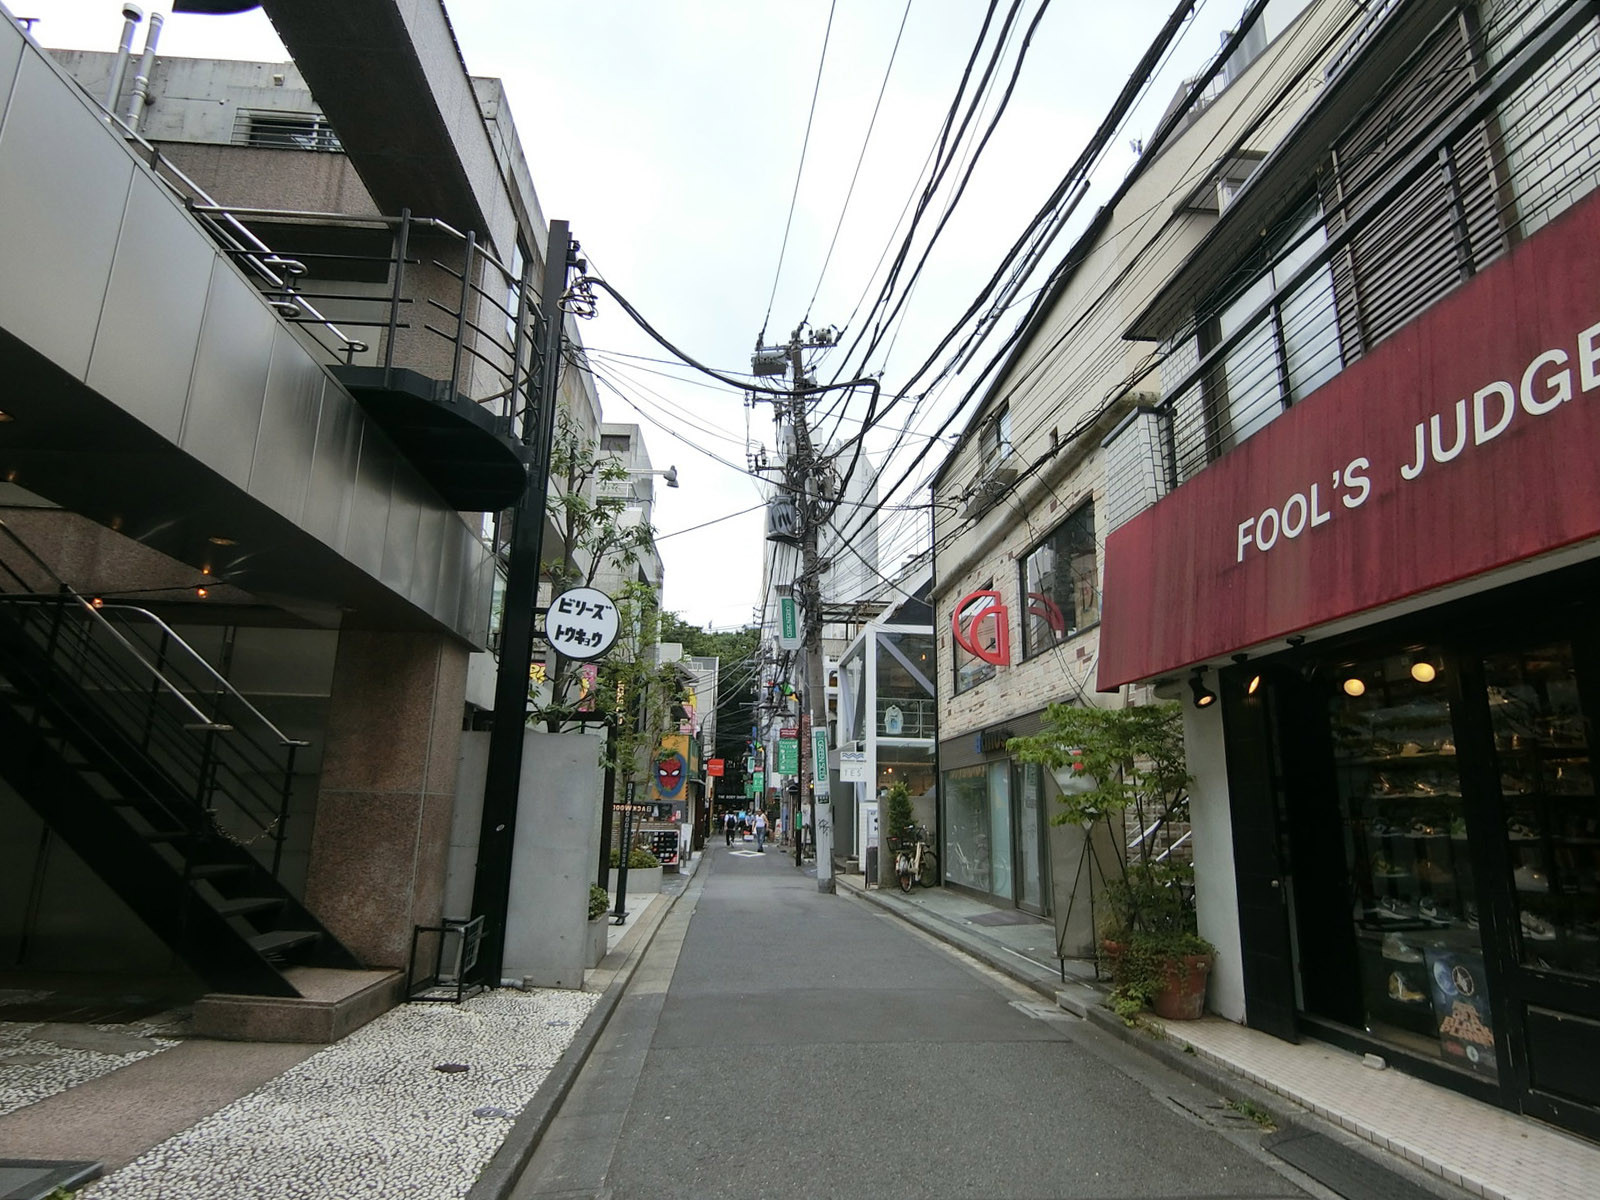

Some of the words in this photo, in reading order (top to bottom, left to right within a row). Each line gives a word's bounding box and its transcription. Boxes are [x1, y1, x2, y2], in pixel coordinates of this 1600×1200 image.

[1237, 457, 1370, 563] FOOL'S
[558, 597, 612, 620] ビリーズ
[554, 624, 603, 648] トウキョウ
[817, 740, 825, 762] GREEN
